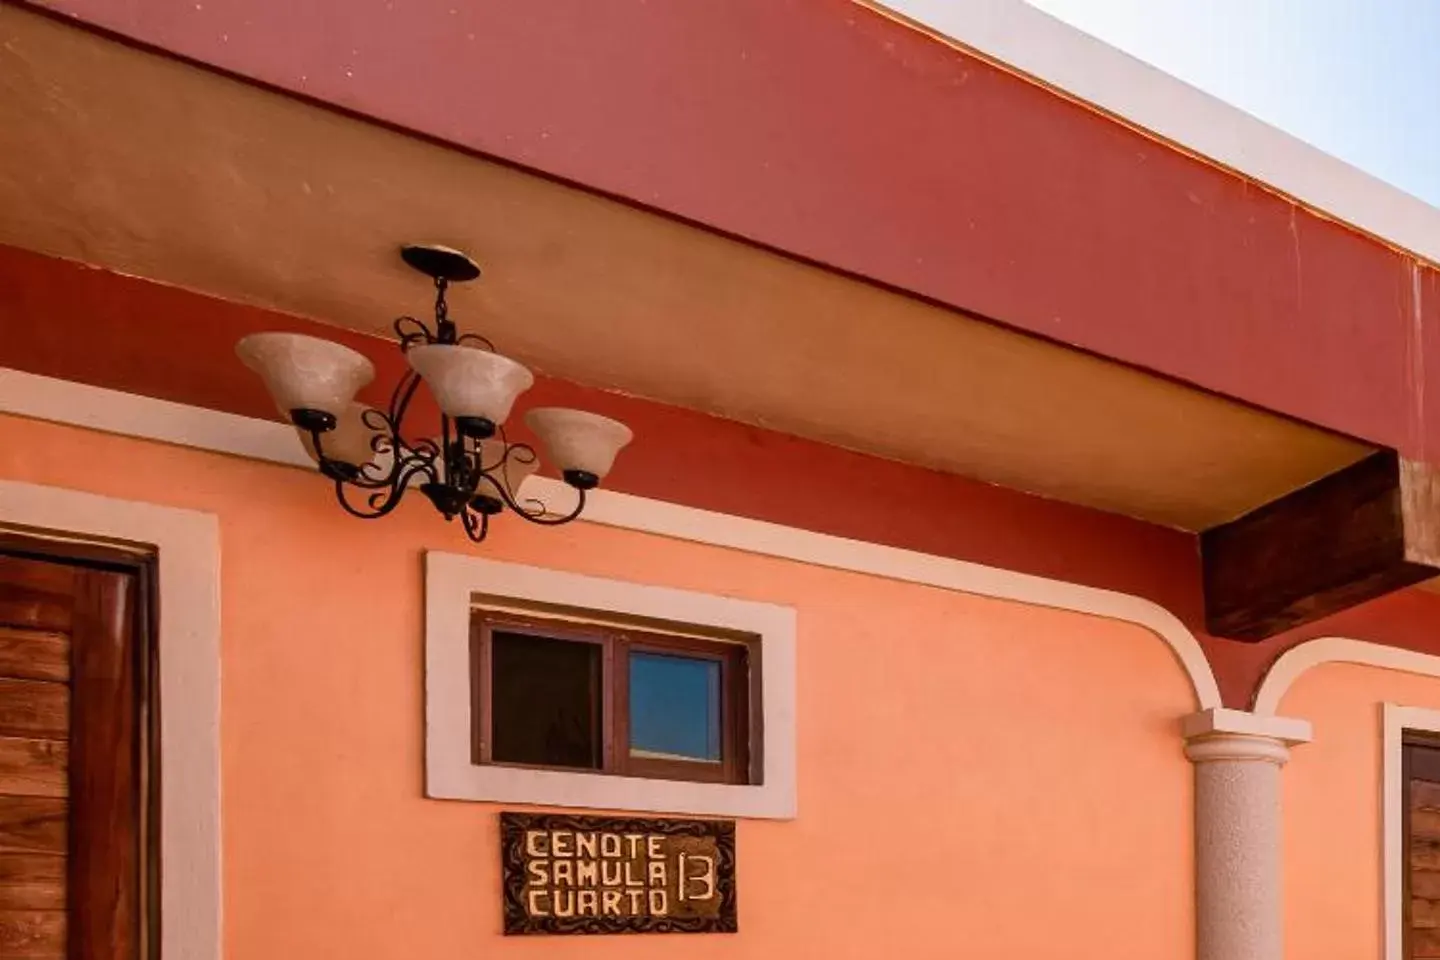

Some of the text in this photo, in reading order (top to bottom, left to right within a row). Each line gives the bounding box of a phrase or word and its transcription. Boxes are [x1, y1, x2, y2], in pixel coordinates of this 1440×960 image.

[527, 831, 666, 858] CENOTE
[528, 860, 667, 886] SAMULA
[678, 852, 714, 900] 13
[529, 889, 668, 916] CUARTO
